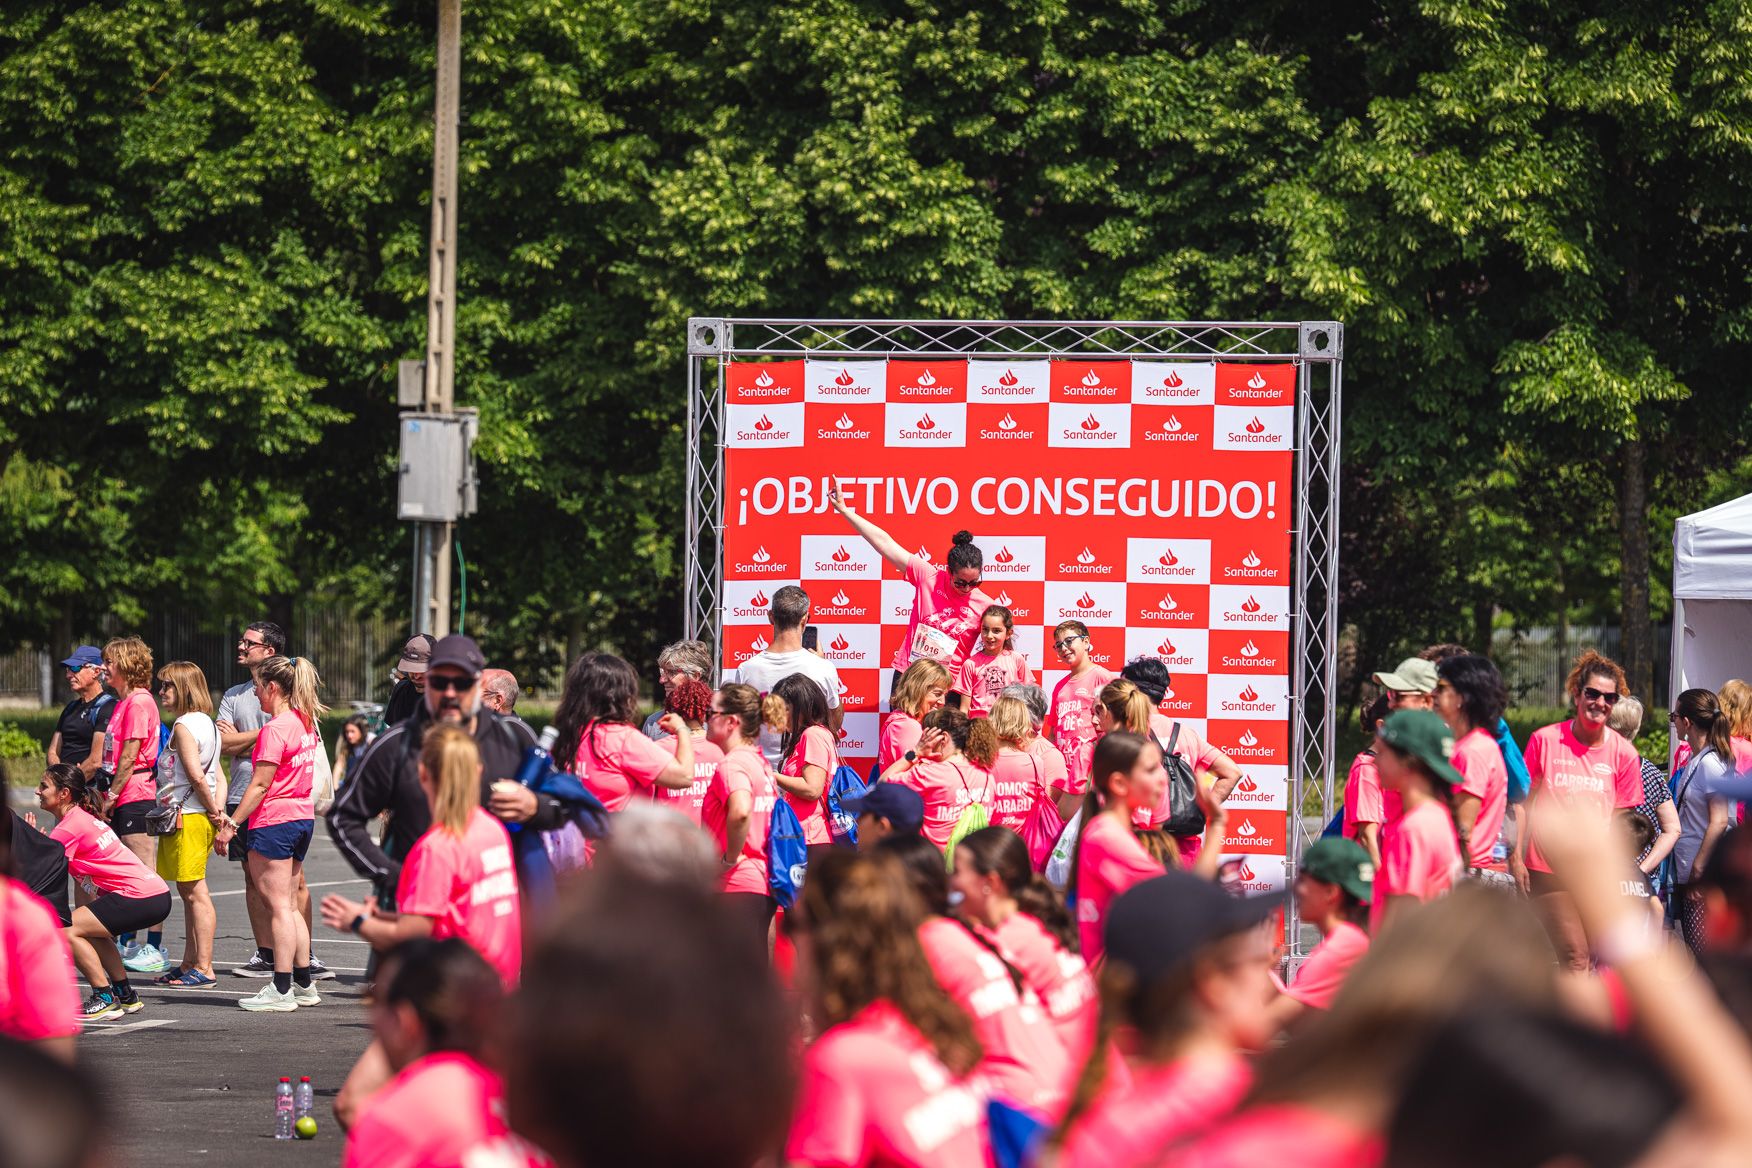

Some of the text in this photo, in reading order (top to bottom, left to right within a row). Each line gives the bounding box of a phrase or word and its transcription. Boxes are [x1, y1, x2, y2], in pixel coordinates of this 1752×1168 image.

[738, 386, 791, 397] Santander
[818, 385, 871, 395] Santander
[899, 385, 953, 395] Santander
[981, 386, 1035, 395] Santander
[1064, 385, 1117, 396] Santander
[1146, 387, 1200, 397] Santander
[1228, 388, 1283, 398] Santander
[737, 430, 790, 440] Santander
[818, 429, 870, 439] Santander
[899, 430, 952, 439] Santander
[980, 430, 1034, 439] Santander
[1064, 430, 1117, 440] Santander
[1145, 431, 1199, 441] Santander
[1228, 432, 1282, 443] Santander
[738, 476, 1276, 526] ¡OBJETIVO CONSEGUIDO!
[735, 563, 787, 573] Santander
[815, 562, 867, 572] Santander
[980, 563, 1030, 572] antander
[1059, 564, 1112, 574] Santander
[1142, 565, 1195, 575] Santander
[1224, 567, 1278, 577] Santander
[734, 607, 769, 616] Santan
[814, 606, 866, 616] Santander
[1059, 608, 1112, 618] Santander
[1141, 610, 1194, 620] Santander
[1224, 612, 1278, 622] Santander
[824, 651, 866, 659] ntander
[1222, 657, 1276, 667] Santander
[1158, 700, 1192, 709] ander
[1222, 701, 1276, 711] Santander
[1221, 746, 1275, 756] Santander
[996, 782, 1028, 796] OMOS
[1227, 793, 1275, 802] antander
[1219, 836, 1273, 846] Santander
